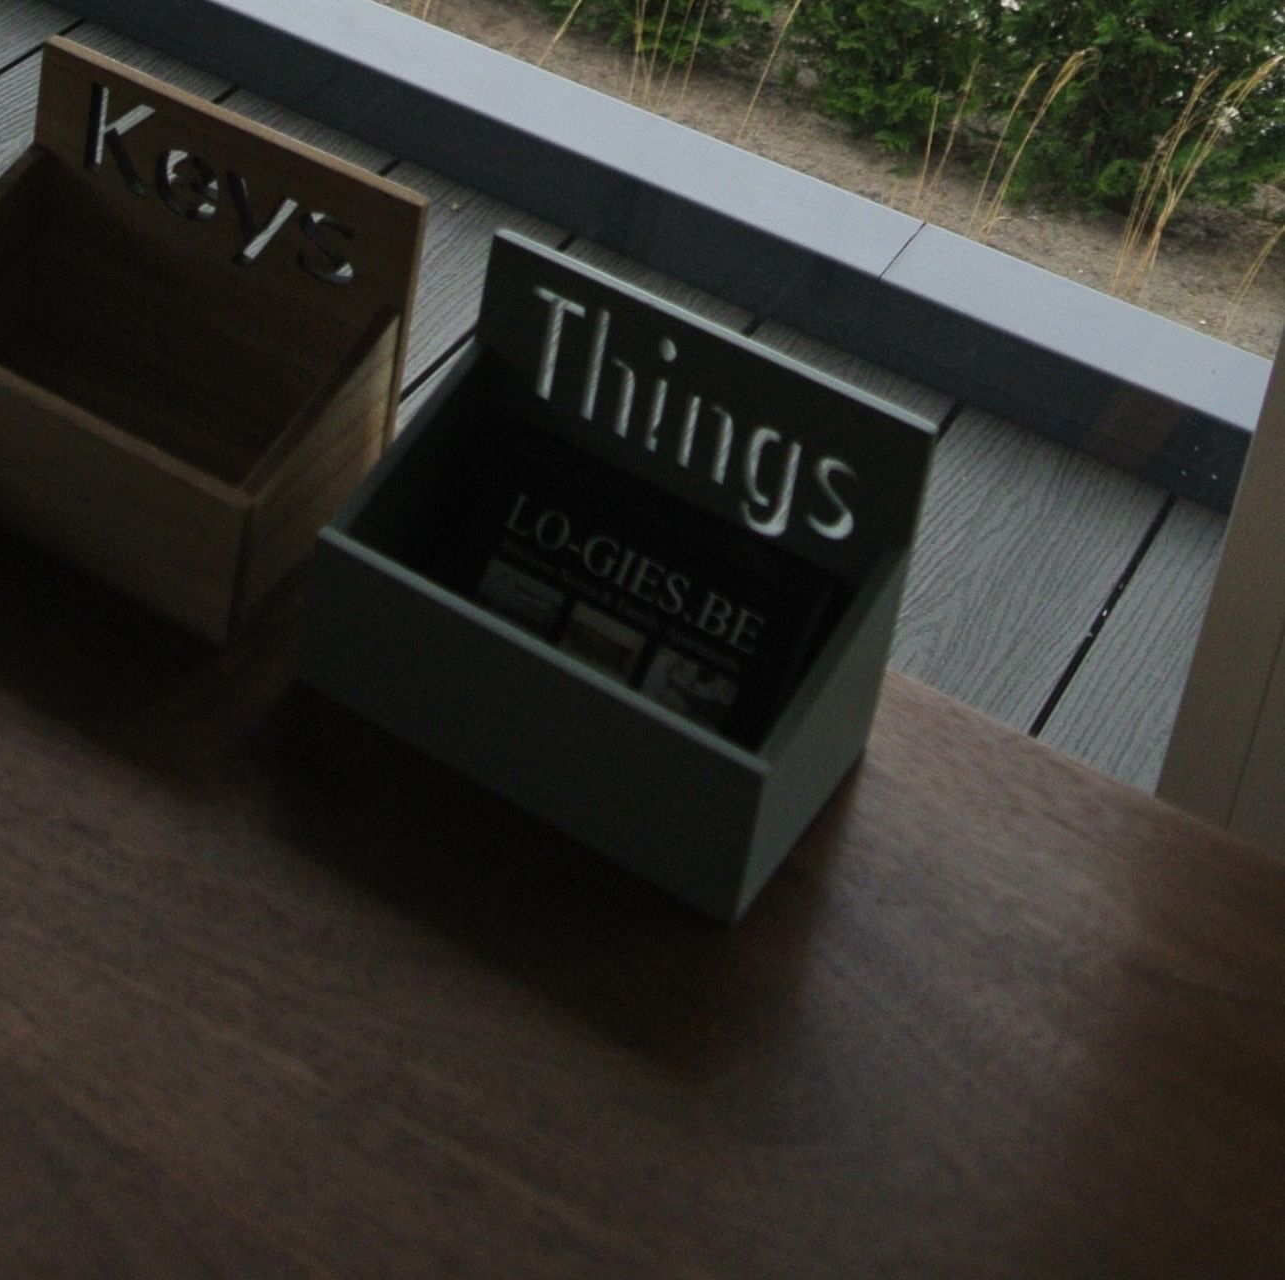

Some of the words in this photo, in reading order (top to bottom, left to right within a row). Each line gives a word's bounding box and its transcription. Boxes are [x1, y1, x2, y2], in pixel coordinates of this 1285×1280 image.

[84, 82, 356, 284] Keys
[533, 285, 857, 540] Things
[505, 494, 765, 655] LO-GIES.BE
